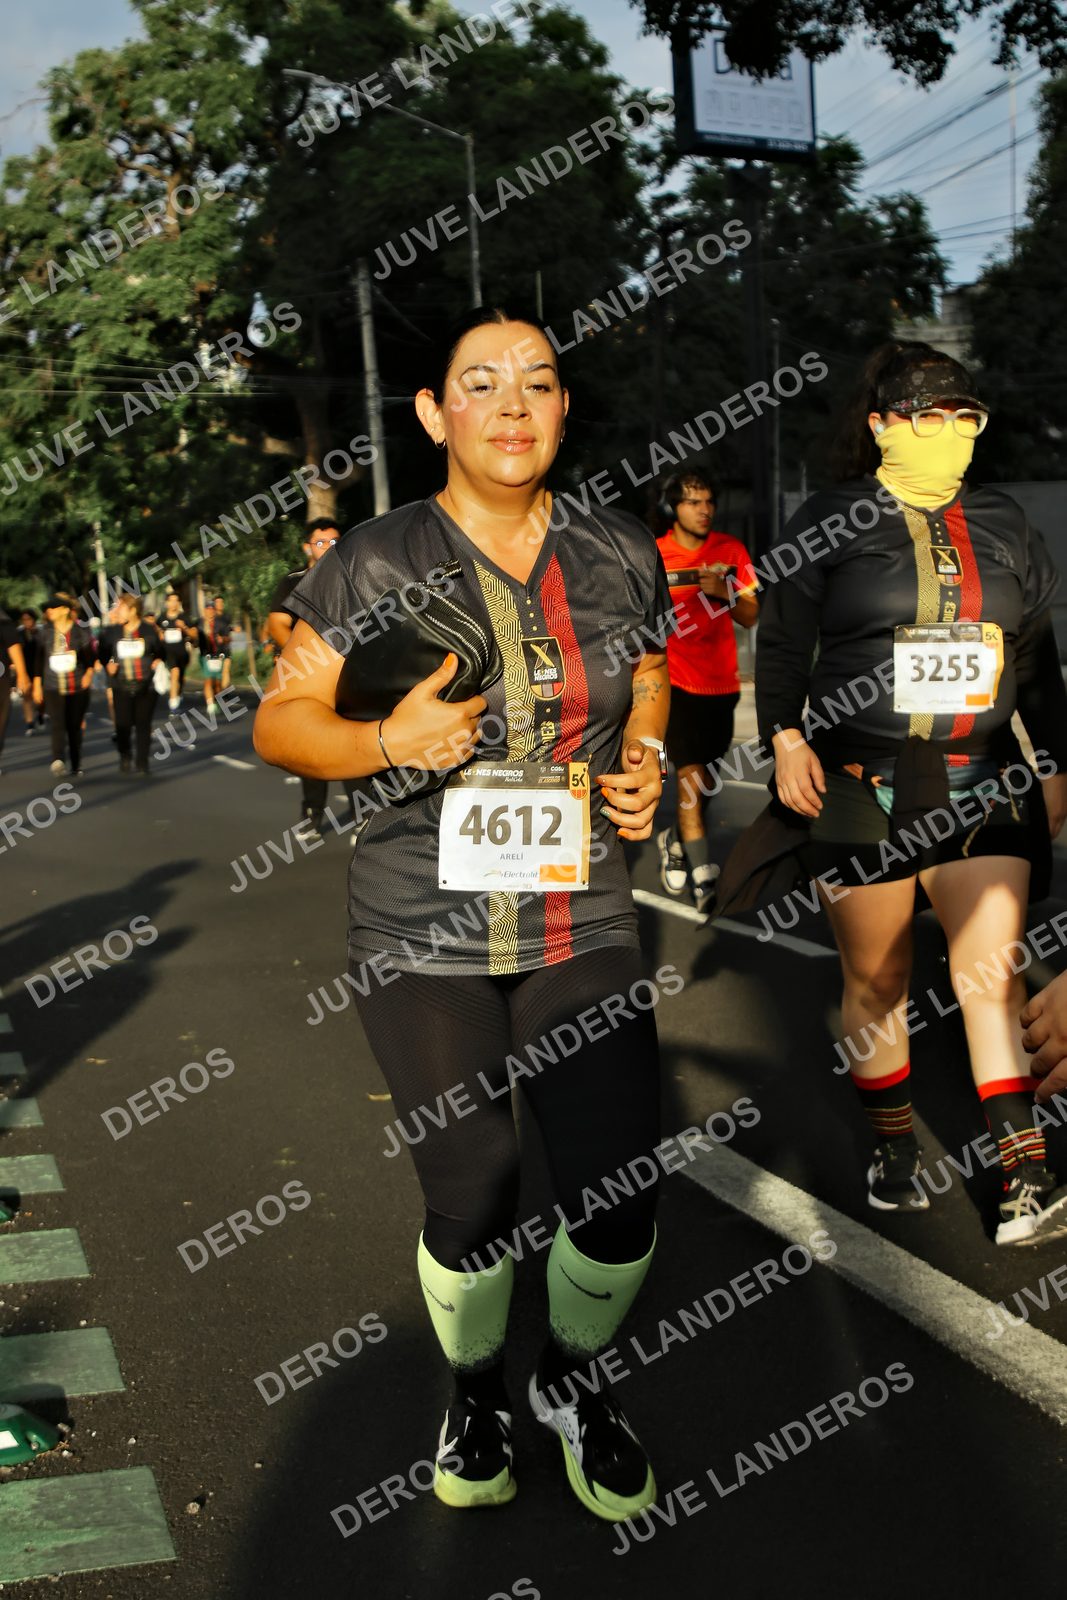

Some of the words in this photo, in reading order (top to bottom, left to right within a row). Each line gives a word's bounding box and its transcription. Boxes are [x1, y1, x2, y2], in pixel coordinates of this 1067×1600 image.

[910, 653, 981, 683] 3255
[492, 769, 524, 777] NEGROS
[458, 804, 563, 846] 4612
